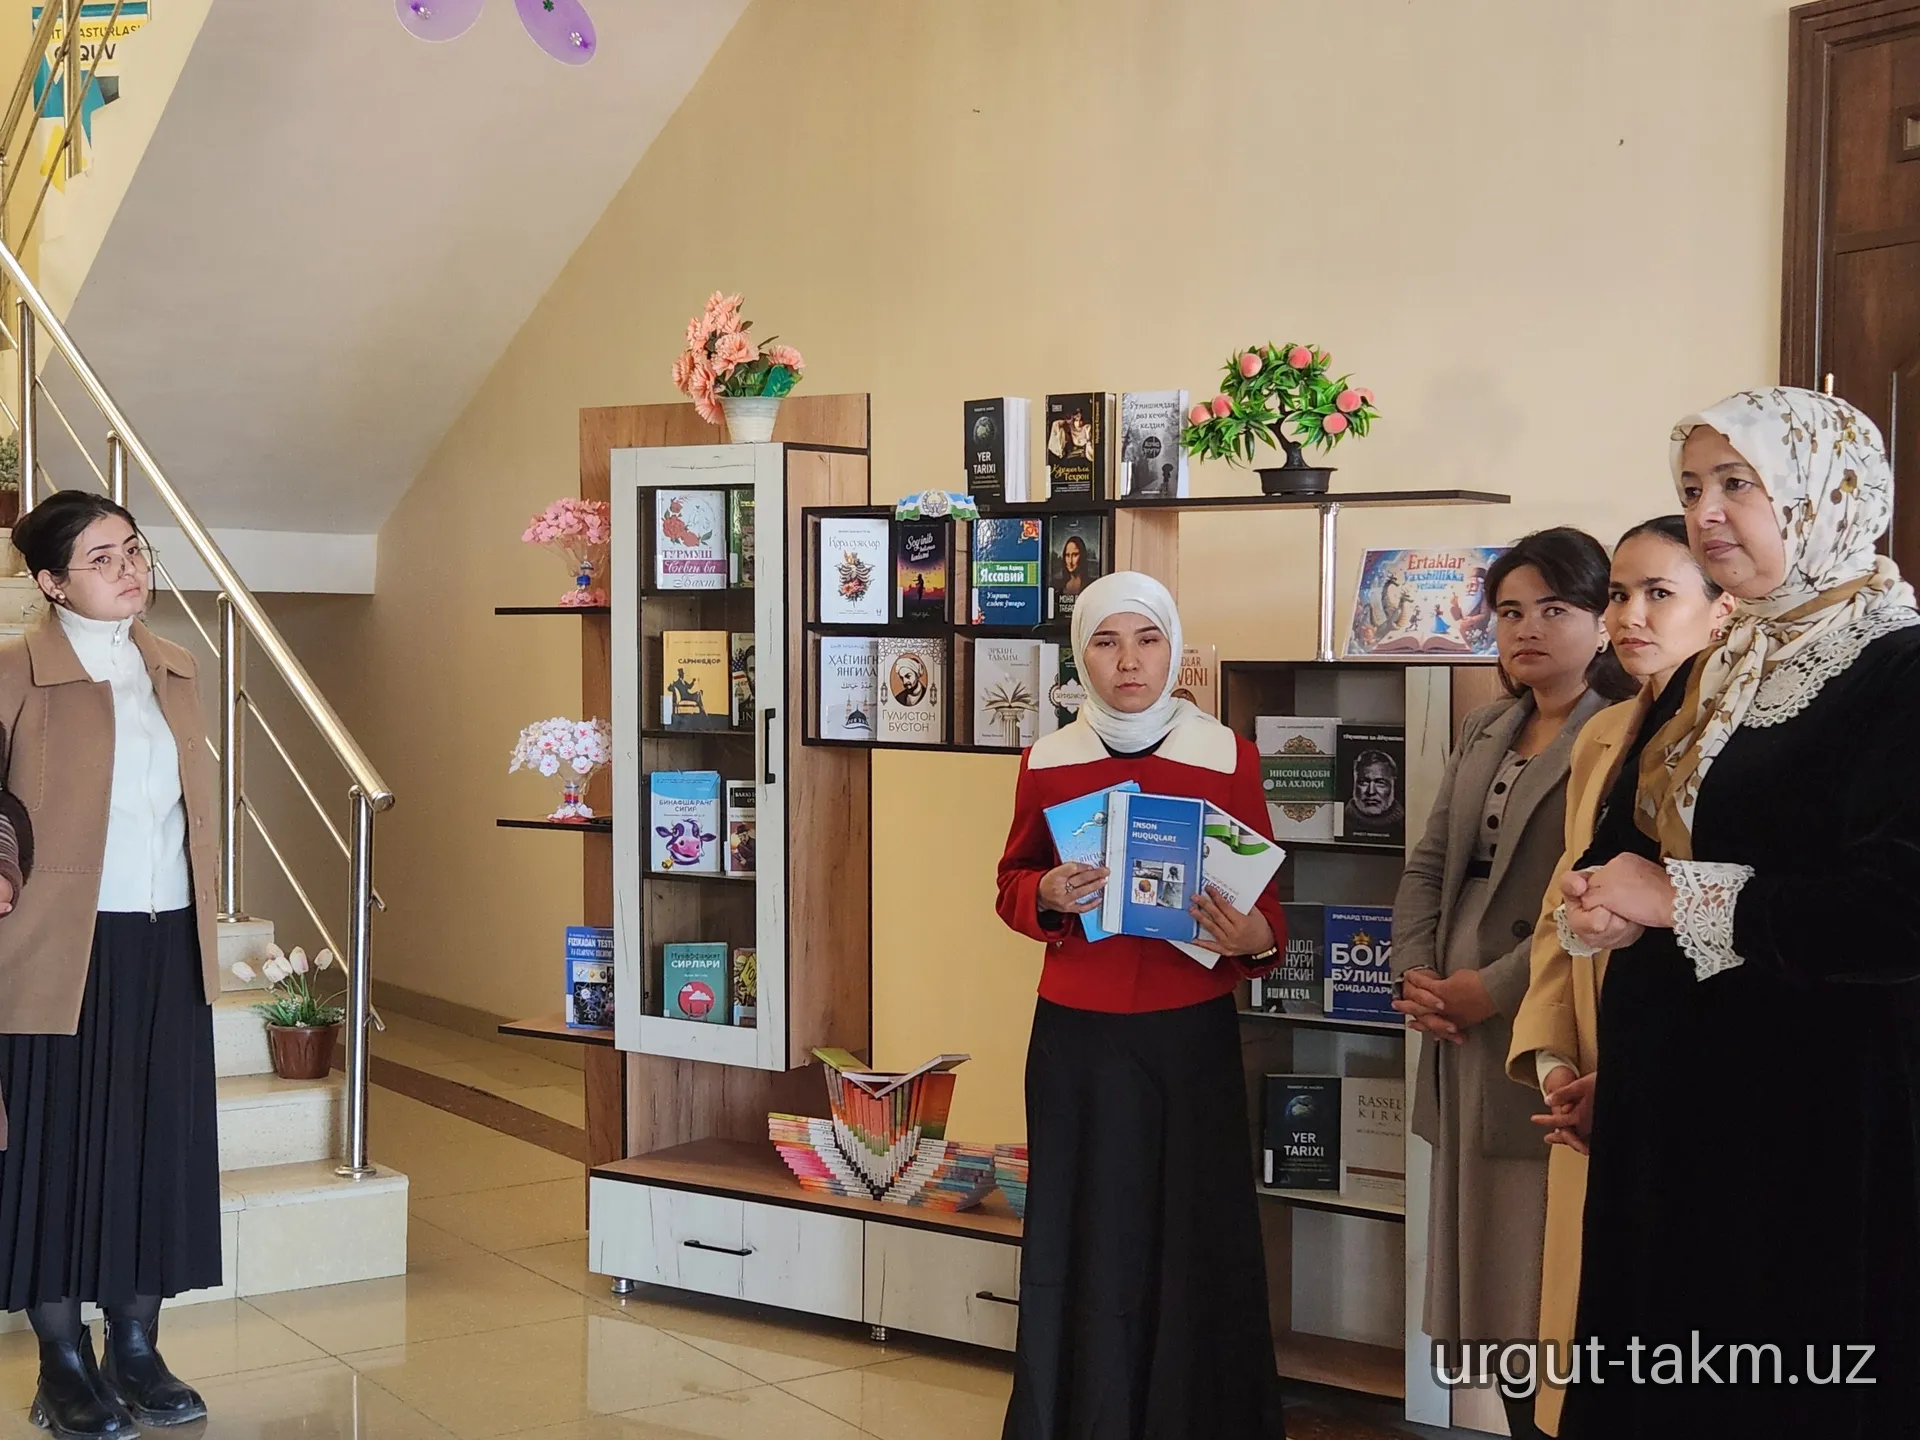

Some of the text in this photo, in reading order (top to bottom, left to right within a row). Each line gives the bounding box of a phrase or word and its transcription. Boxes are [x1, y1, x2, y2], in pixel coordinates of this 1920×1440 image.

[79, 24, 141, 38] ASTURLAS
[977, 452, 991, 462] YER
[973, 464, 996, 475] TARIXI
[662, 550, 713, 559] ТУРМУШ
[1407, 553, 1466, 570] Ertaklar
[980, 567, 1024, 583] Яссавий
[882, 710, 936, 722] ГУЛИСТОН
[1269, 769, 1300, 778] ИНСОН
[1275, 780, 1287, 788] ВА
[1132, 821, 1157, 831] INSON
[1131, 831, 1177, 844] HUQUQLARI
[597, 939, 614, 949] TESTL
[1286, 939, 1314, 954] ШОД
[671, 960, 721, 969] СИРЛАРИ
[1285, 954, 1314, 968] НУРИ
[1263, 967, 1314, 982] УНТЕКИН
[1292, 1132, 1317, 1144] YER
[1284, 1145, 1325, 1157] TARIXI
